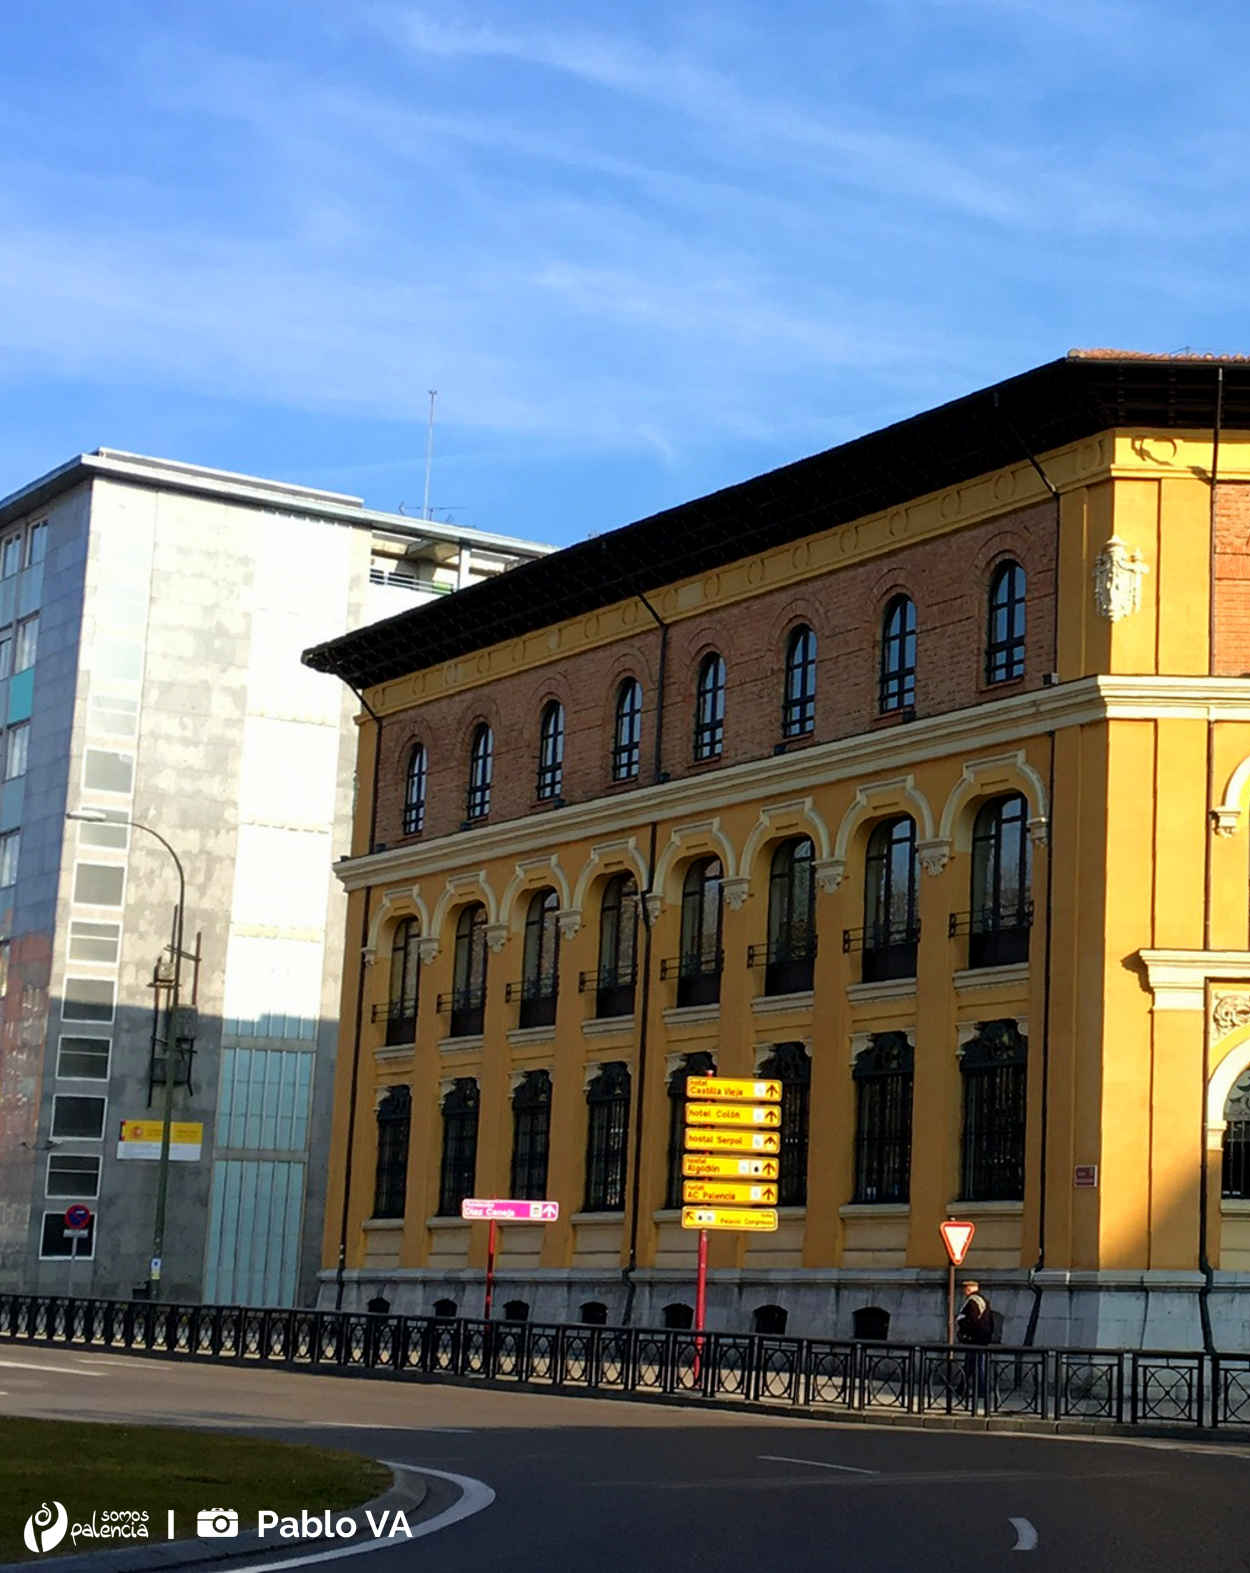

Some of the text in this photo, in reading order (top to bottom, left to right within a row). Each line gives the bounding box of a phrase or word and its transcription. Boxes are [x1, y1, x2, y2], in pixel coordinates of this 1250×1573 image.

[690, 1086, 743, 1098] Castilla Vieja
[689, 1110, 740, 1118] hotel Colón
[689, 1135, 713, 1143] hostal
[703, 1191, 736, 1200] Palencia
